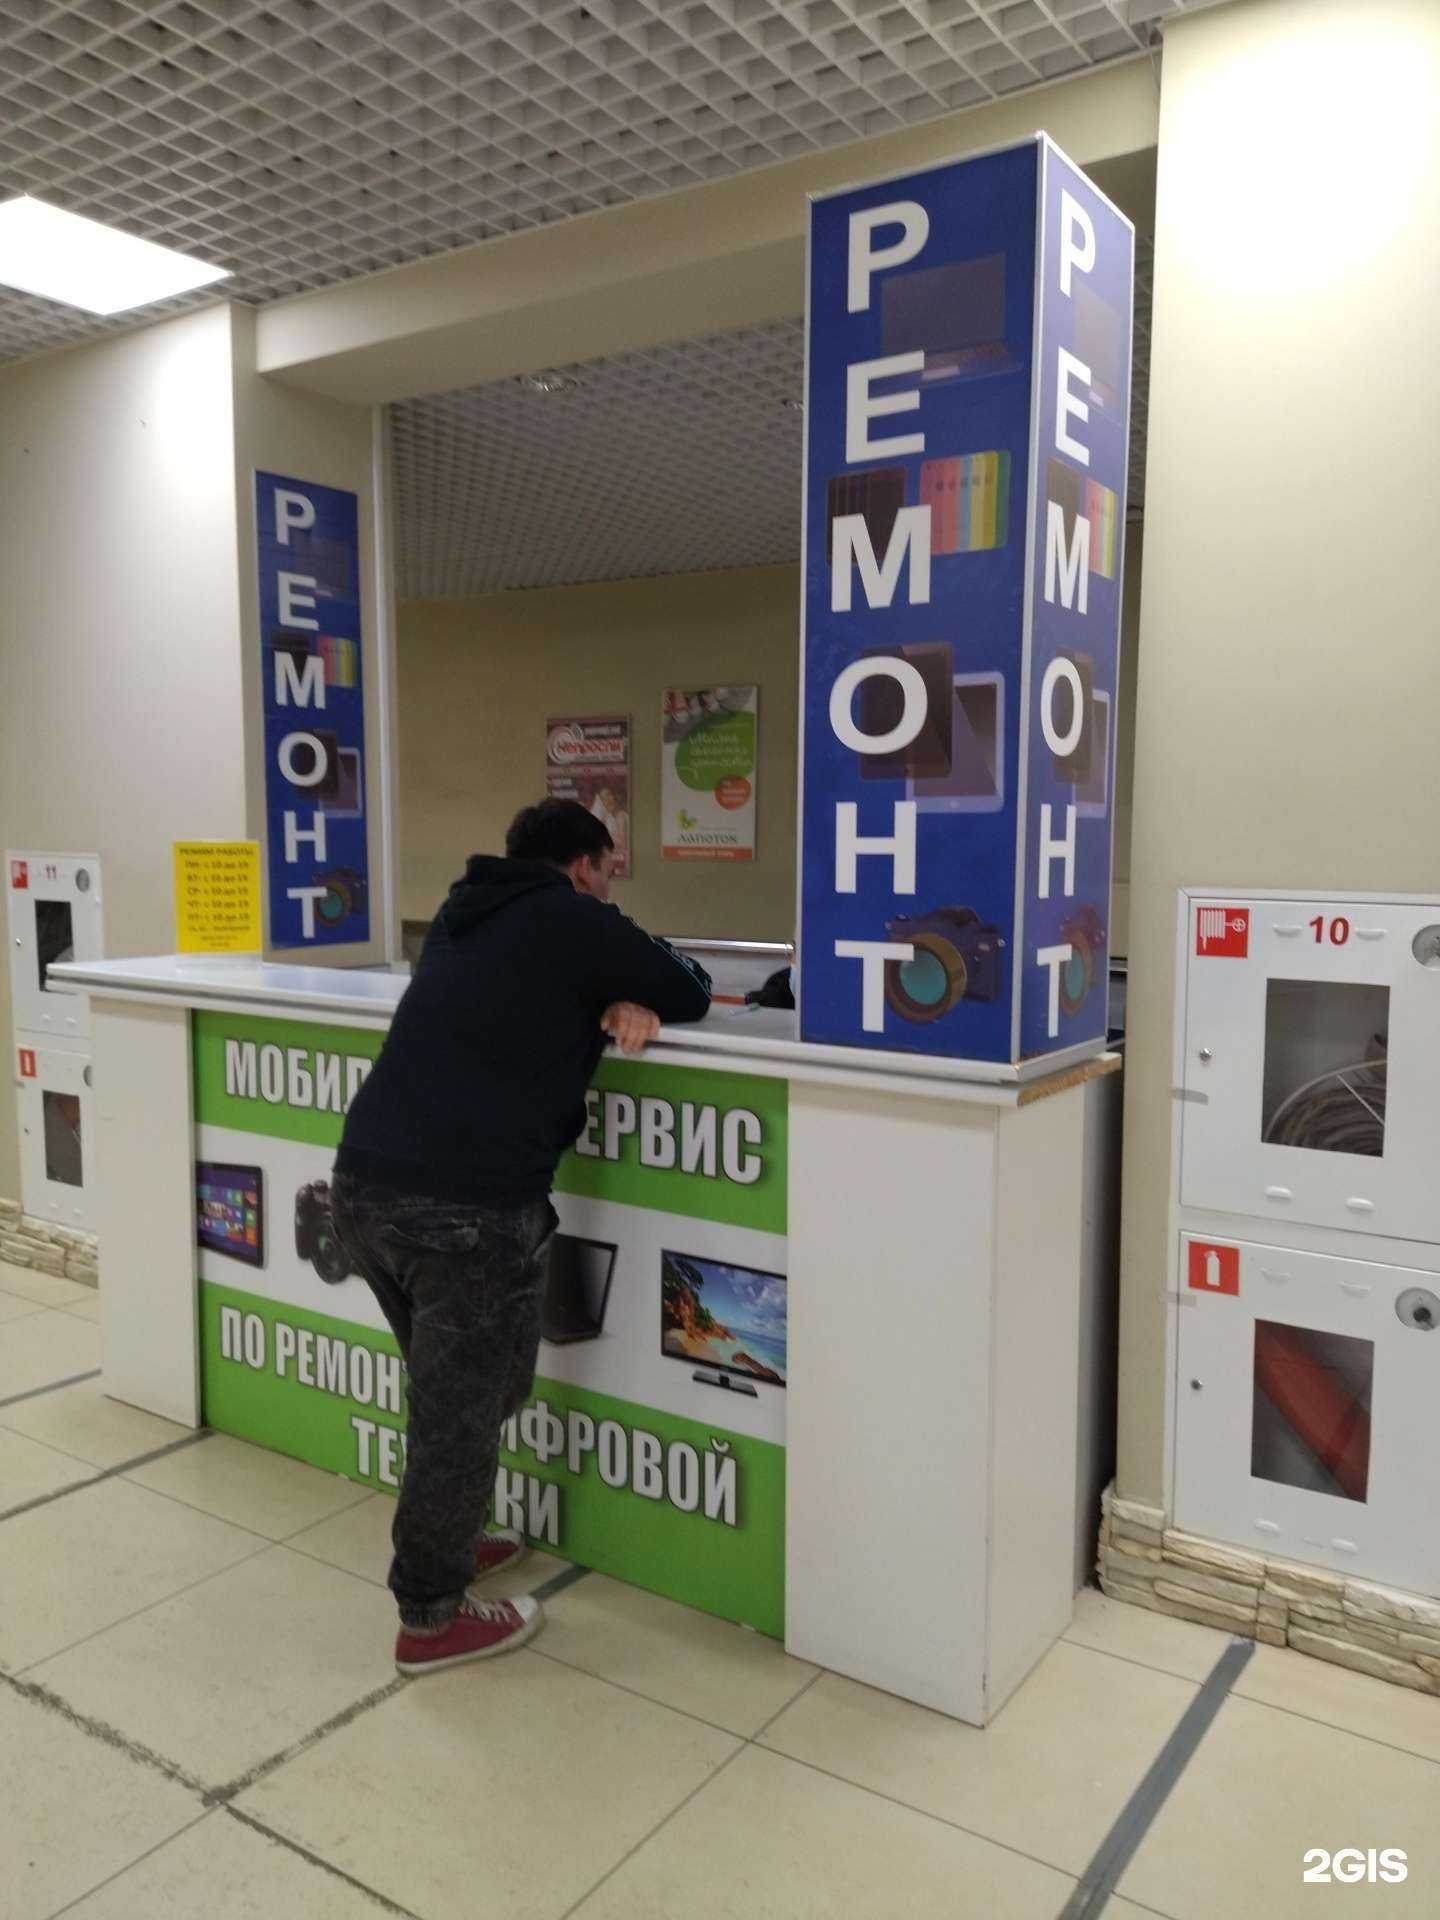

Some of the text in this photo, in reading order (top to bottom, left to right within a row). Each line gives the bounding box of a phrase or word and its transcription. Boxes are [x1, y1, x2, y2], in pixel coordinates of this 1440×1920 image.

[273, 487, 329, 939] РЕМОНТ
[829, 200, 932, 1034] РЕМОНТ
[1037, 188, 1096, 1037] РЕМОНТ
[1309, 915, 1350, 946] 10
[223, 1037, 763, 1185] МОБИЛ ЕРВИС
[220, 1304, 266, 1369] ПО
[274, 1320, 408, 1415] РЕМОН
